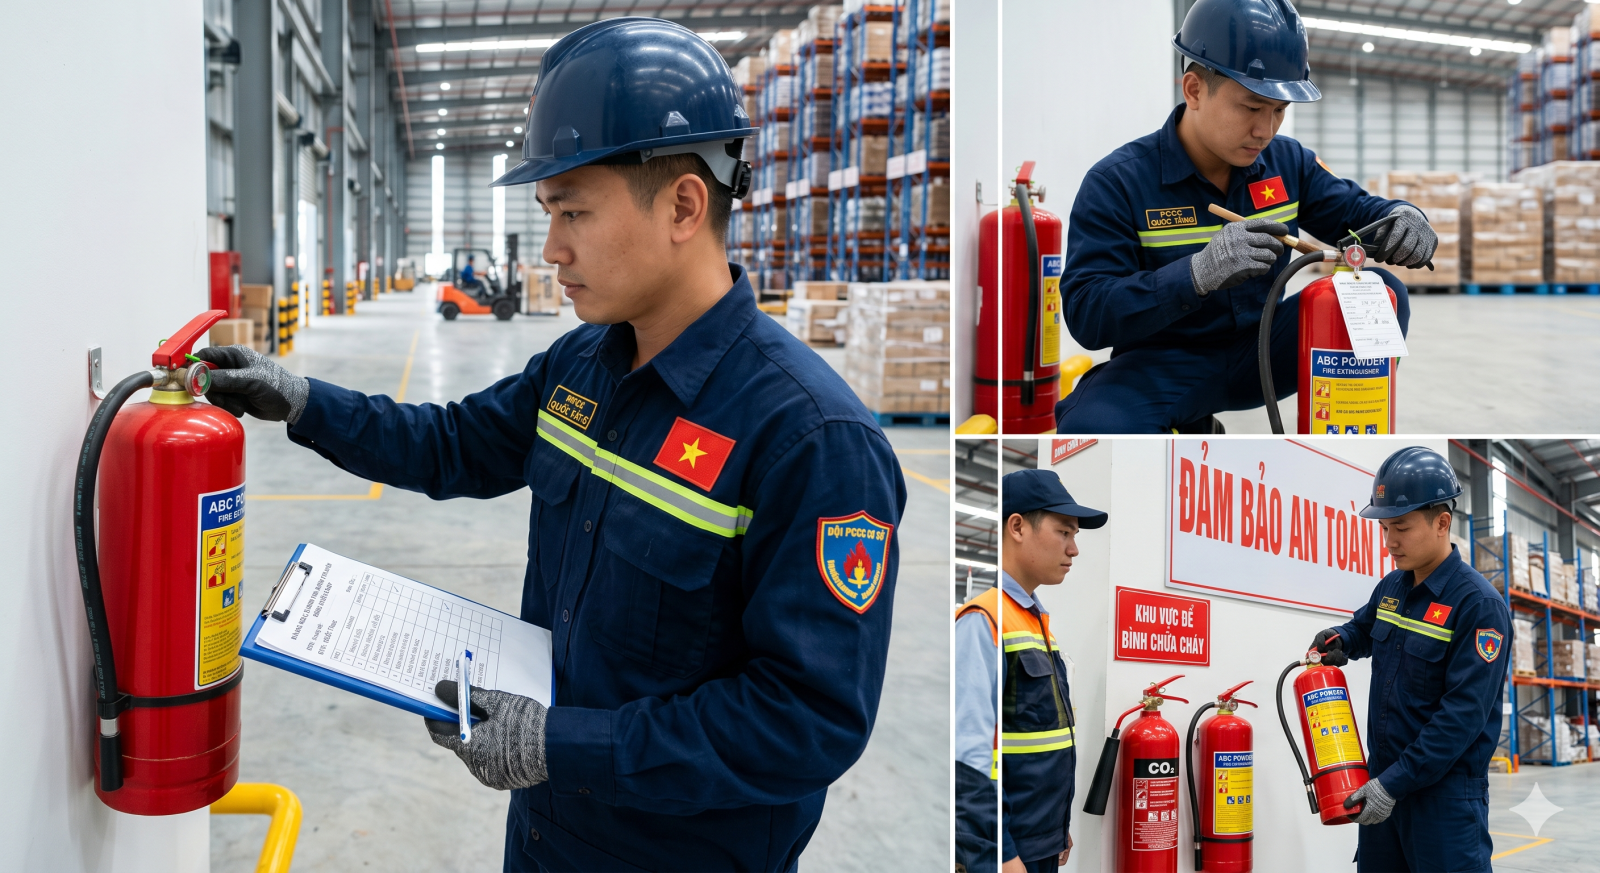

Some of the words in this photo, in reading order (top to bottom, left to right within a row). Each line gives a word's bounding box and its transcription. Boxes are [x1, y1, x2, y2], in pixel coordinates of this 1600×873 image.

[1160, 209, 1183, 218] PCCC
[1316, 355, 1338, 366] ABC
[208, 497, 234, 514] ABC
[1179, 441, 1234, 544] ĐẢM
[1241, 461, 1283, 556] BẢO
[1289, 494, 1318, 564] AN
[1324, 500, 1374, 577] TOÀN
[218, 512, 233, 523] FIRE
[845, 527, 867, 538] PCCC
[1135, 603, 1157, 624] KHU
[1159, 606, 1179, 629] VỰC
[1181, 604, 1194, 628] ĐỂ
[1121, 626, 1148, 650] BÌNH
[1150, 630, 1177, 653] CHỮA
[1179, 634, 1204, 655] CHÁY
